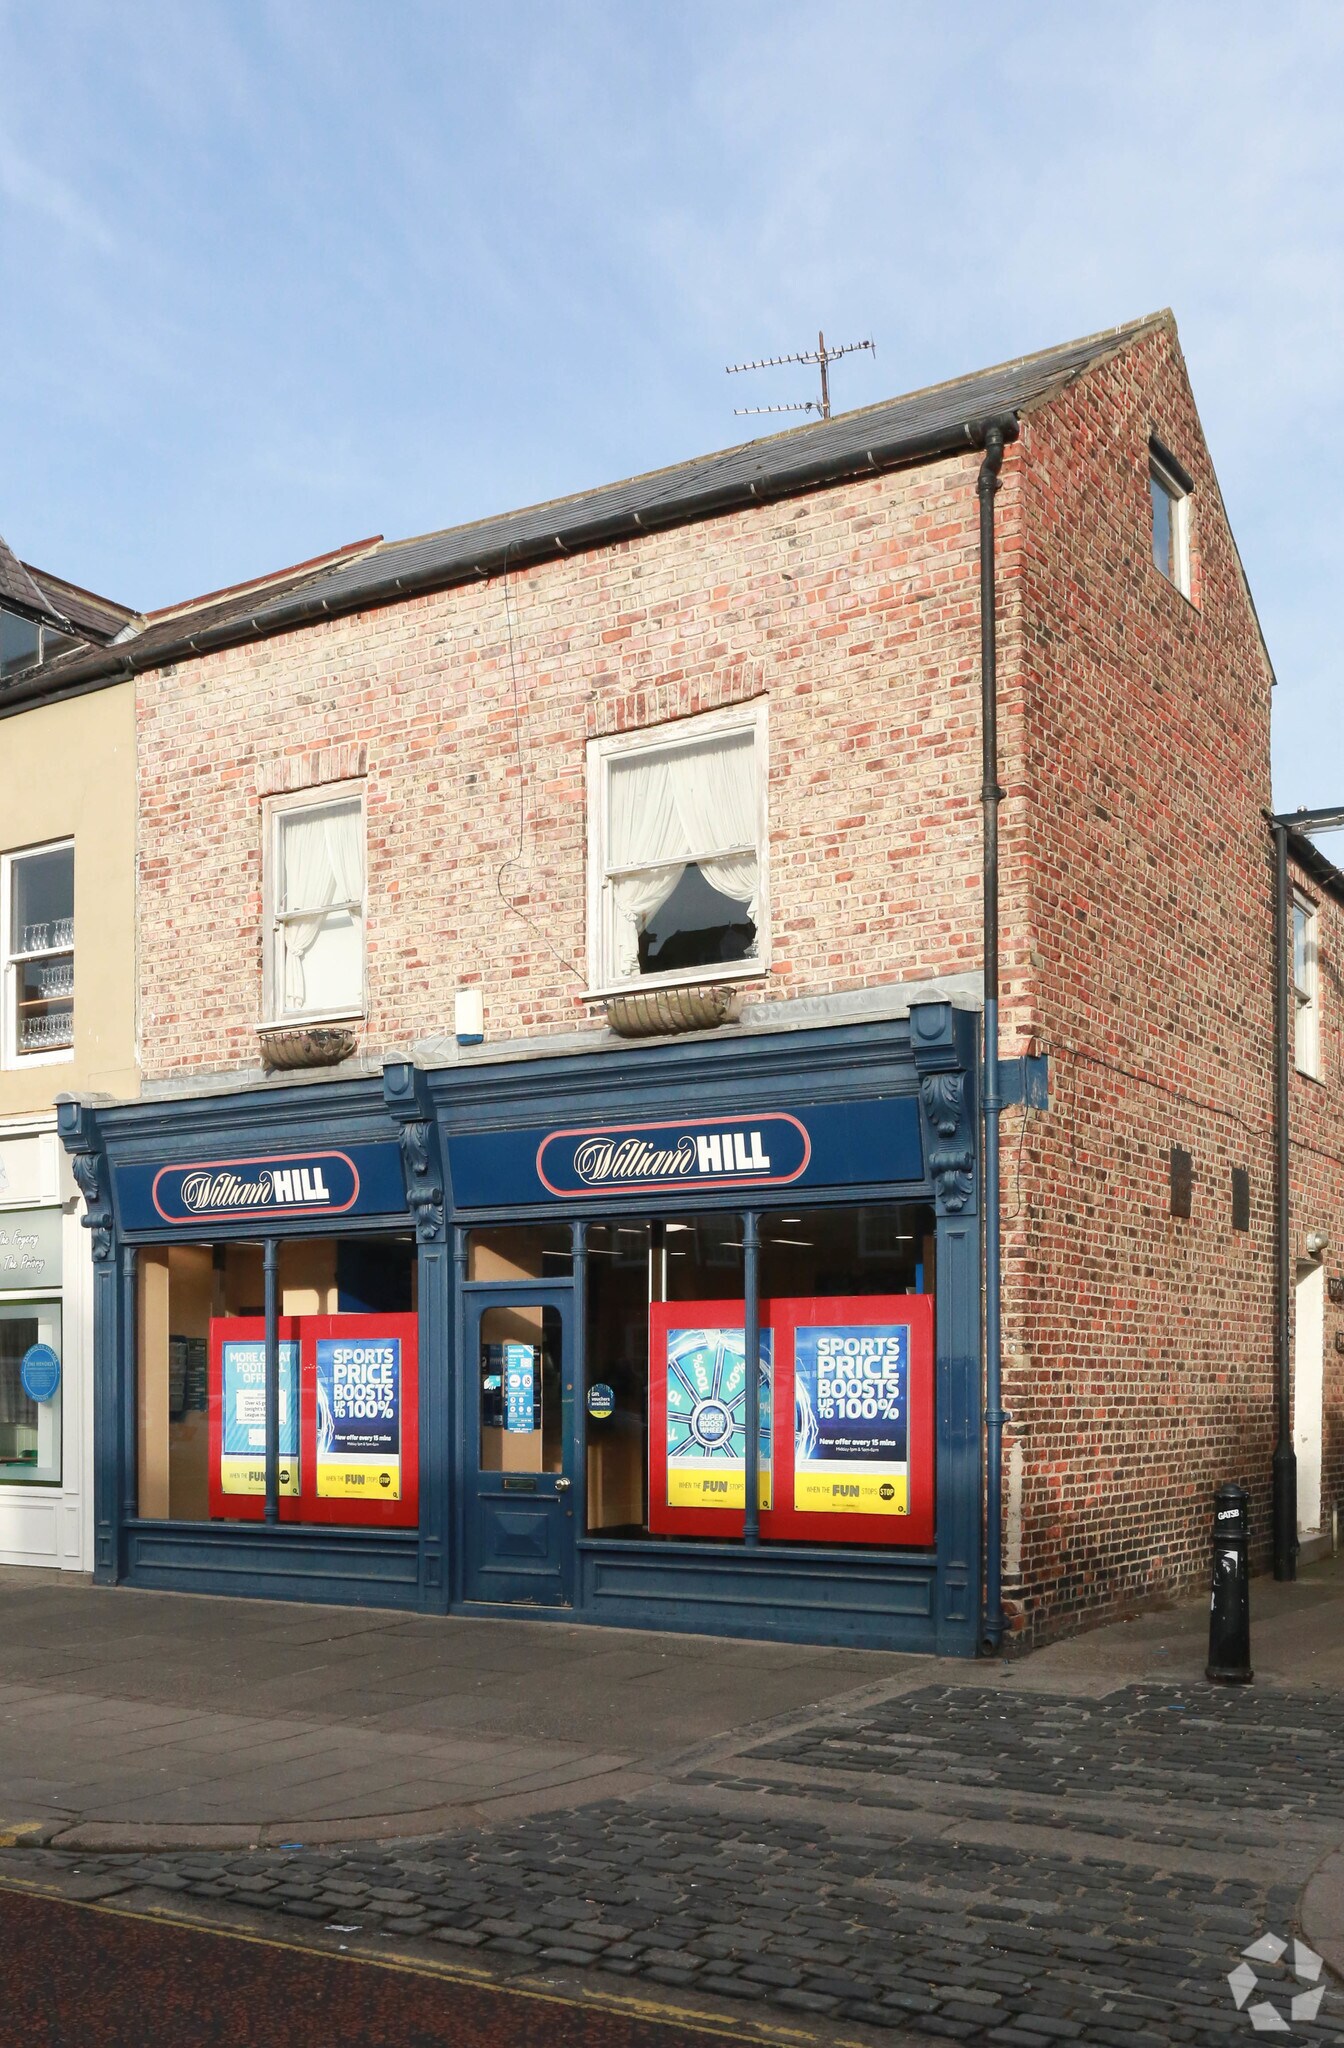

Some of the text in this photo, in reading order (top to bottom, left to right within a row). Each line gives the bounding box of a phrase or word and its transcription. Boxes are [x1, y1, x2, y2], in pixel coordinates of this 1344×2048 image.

[574, 1131, 771, 1181] William HILL
[181, 1167, 330, 1209] William HILL
[20, 1254, 45, 1274] Priory
[817, 1337, 900, 1356] SPORTS
[229, 1352, 259, 1362] MORE
[333, 1348, 393, 1364] SPORTS
[333, 1364, 394, 1384] PRICE
[693, 1353, 709, 1393] 100%
[817, 1355, 900, 1379] PRICE
[333, 1384, 394, 1401] BOOSTS
[817, 1379, 900, 1399] BOOSTS
[333, 1400, 394, 1418] UP 100%
[333, 1409, 345, 1418] TO
[817, 1398, 900, 1420] UP 100%
[817, 1408, 834, 1419] TO
[852, 1439, 870, 1447] every
[345, 1474, 365, 1485] FUN
[702, 1480, 728, 1492] FUN
[832, 1485, 860, 1497] FUN
[880, 1488, 894, 1496] STOP
